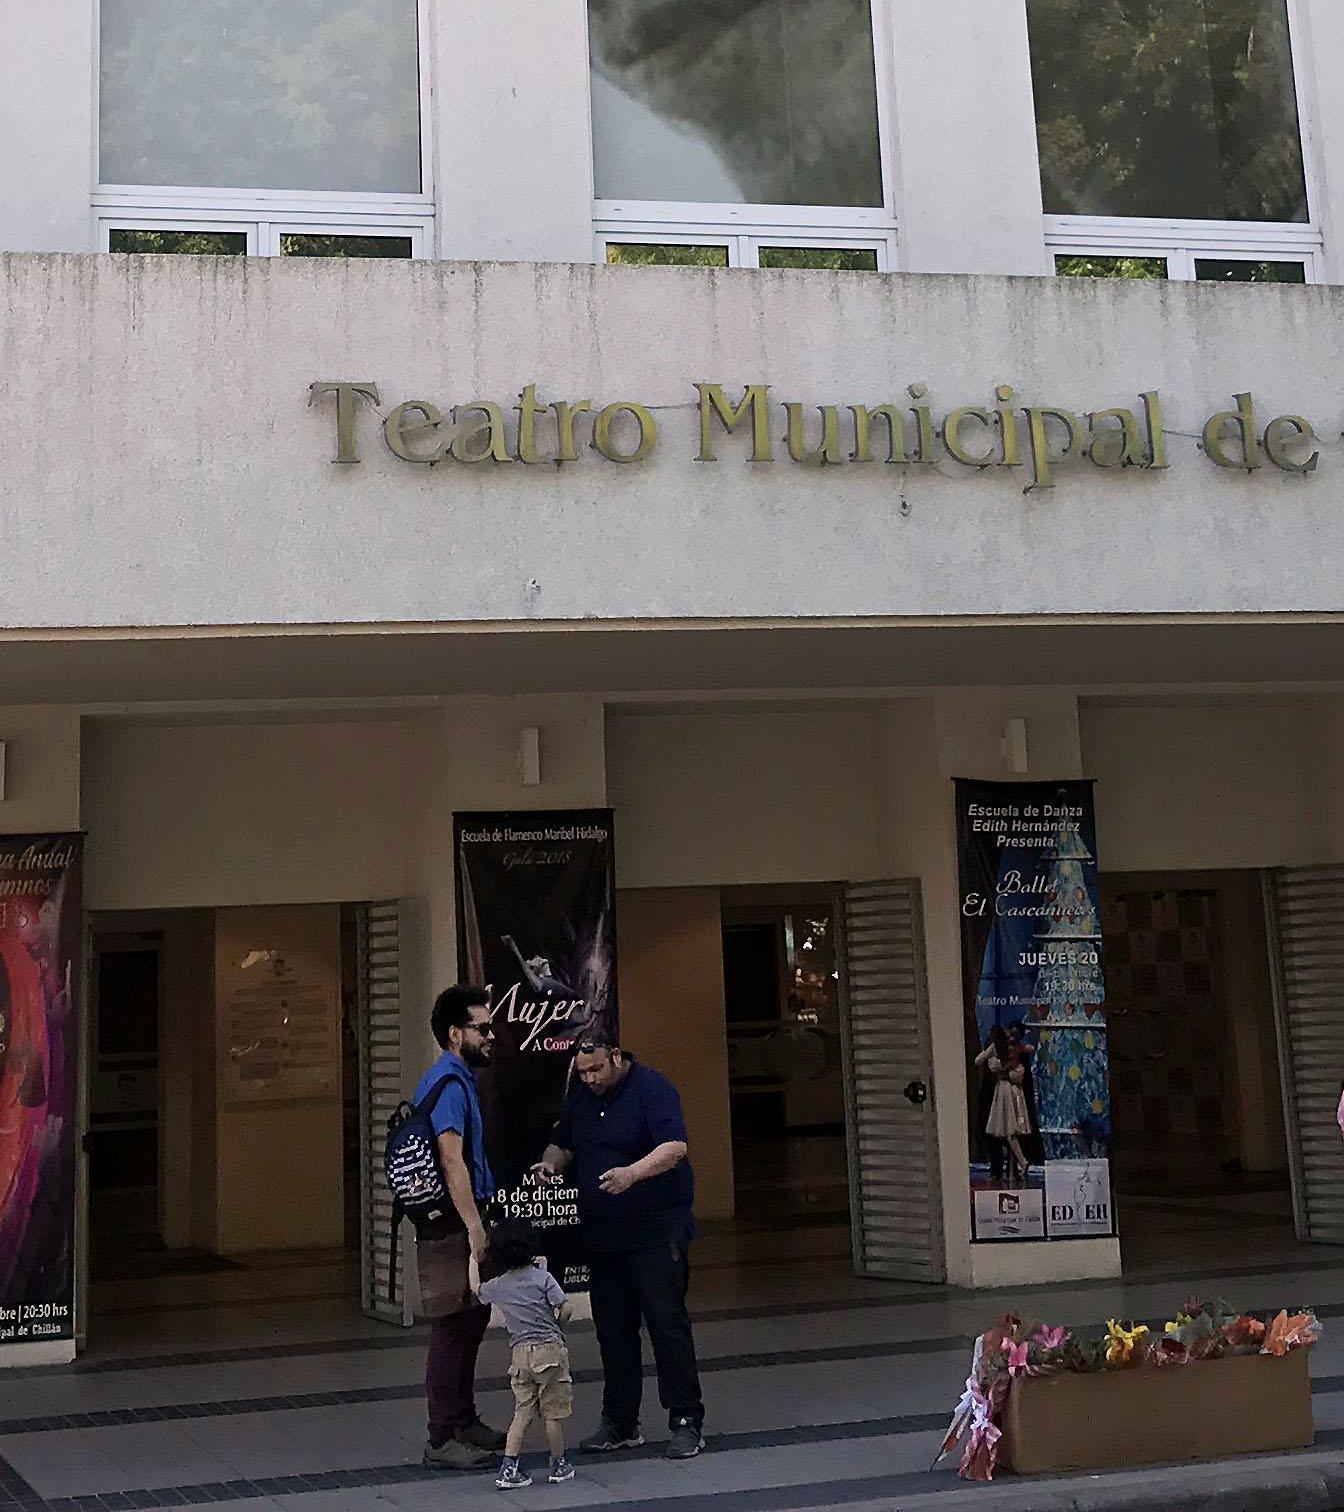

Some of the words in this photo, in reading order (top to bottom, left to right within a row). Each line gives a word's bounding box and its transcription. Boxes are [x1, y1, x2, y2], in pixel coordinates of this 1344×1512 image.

[309, 379, 659, 468] Teatro
[692, 381, 1170, 494] Municipal
[1202, 391, 1321, 477] de
[968, 804, 1020, 817] Escuela
[1023, 805, 1040, 817] de
[1043, 805, 1084, 817] Danza
[972, 819, 1008, 832] Edith
[1011, 819, 1081, 832] Hernández
[1018, 952, 1077, 966] JUEVES
[1081, 952, 1099, 965] 20
[510, 1186, 529, 1203] de
[532, 1186, 579, 1201] diciem
[503, 1202, 544, 1218] 19:30
[547, 1201, 578, 1216] hora
[23, 1303, 52, 1320] 20:30
[53, 1302, 69, 1317] hrs
